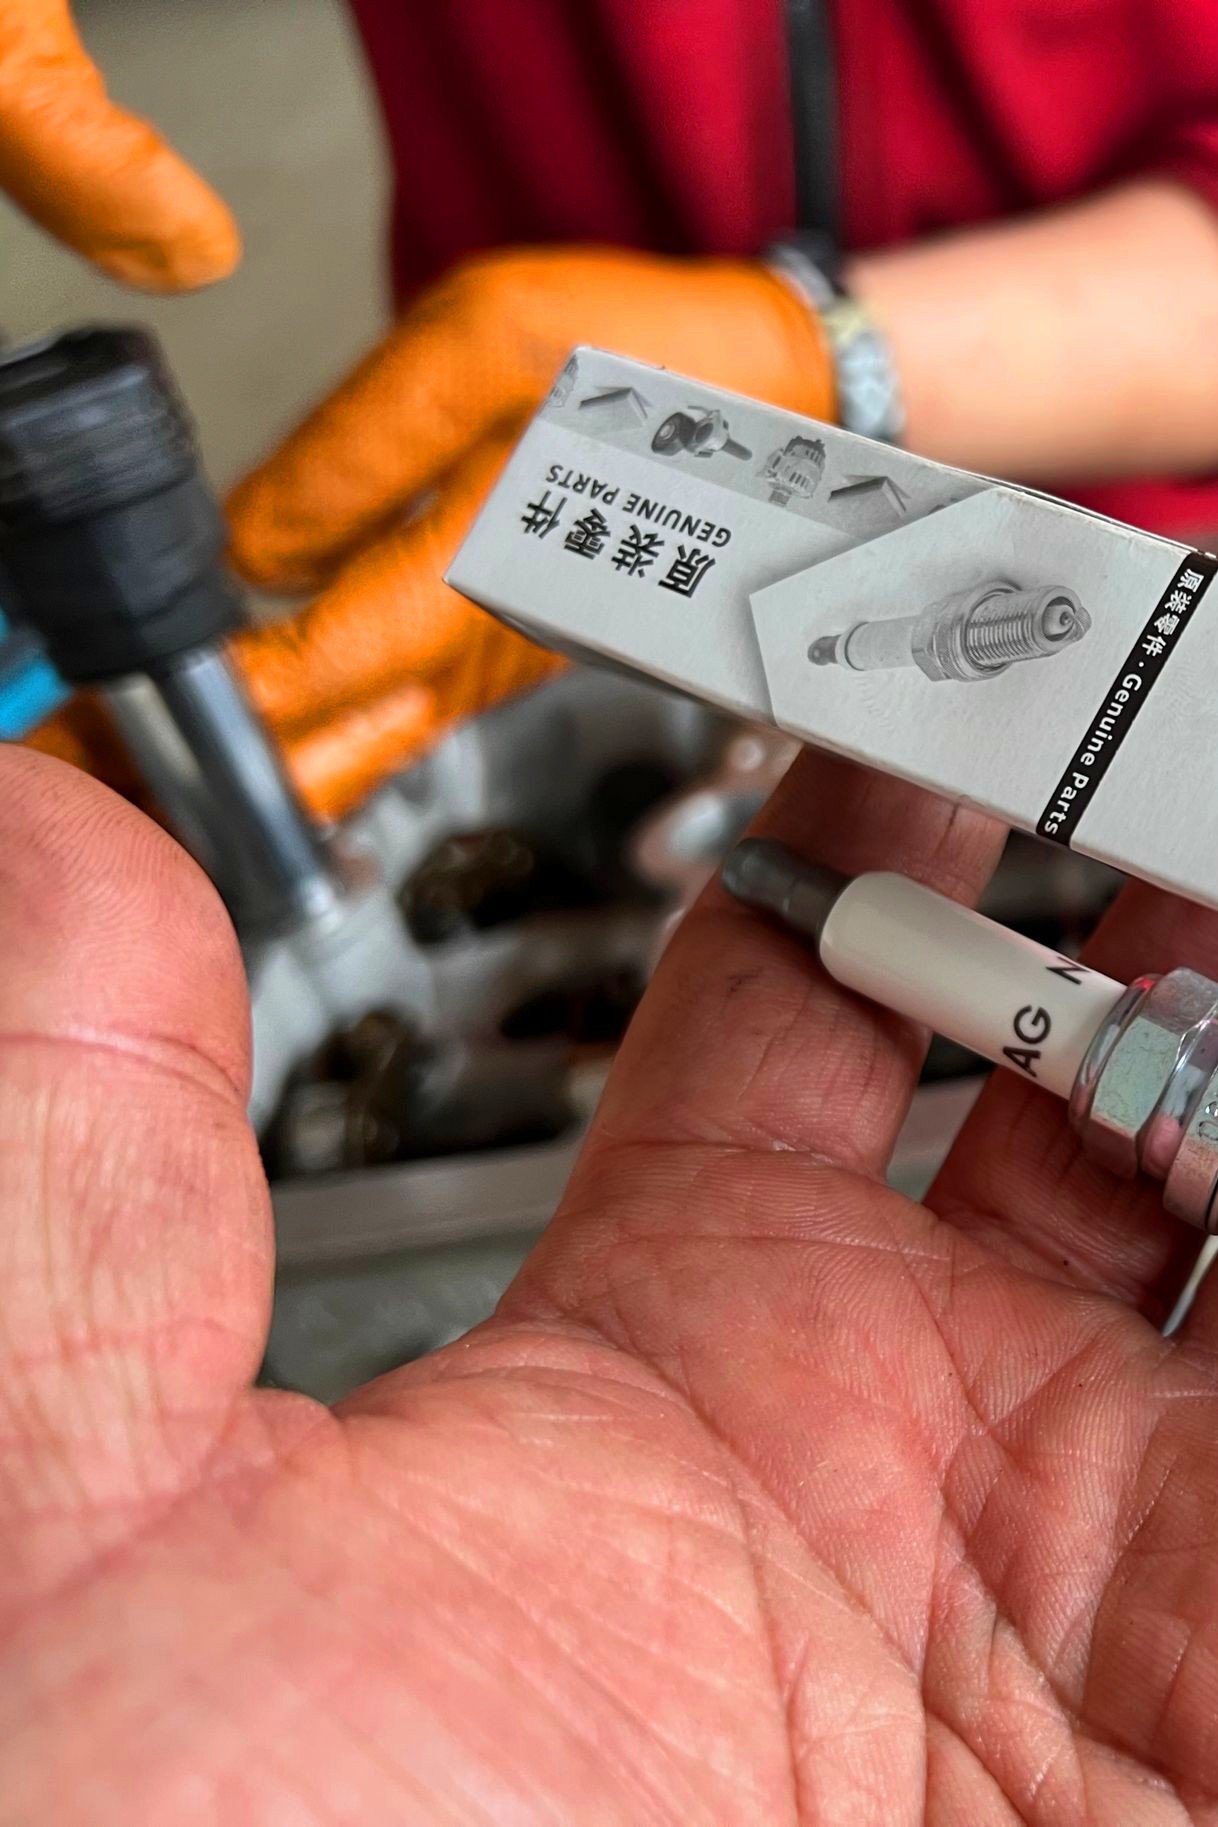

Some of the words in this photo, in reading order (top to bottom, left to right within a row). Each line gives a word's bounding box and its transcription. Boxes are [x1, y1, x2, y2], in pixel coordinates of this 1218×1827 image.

[545, 464, 621, 506] PARTS
[521, 490, 716, 598] 原装零件
[622, 493, 732, 548] GENUINE
[1080, 673, 1143, 766] Genuine
[1044, 772, 1090, 835] Parts
[1045, 956, 1092, 985] N
